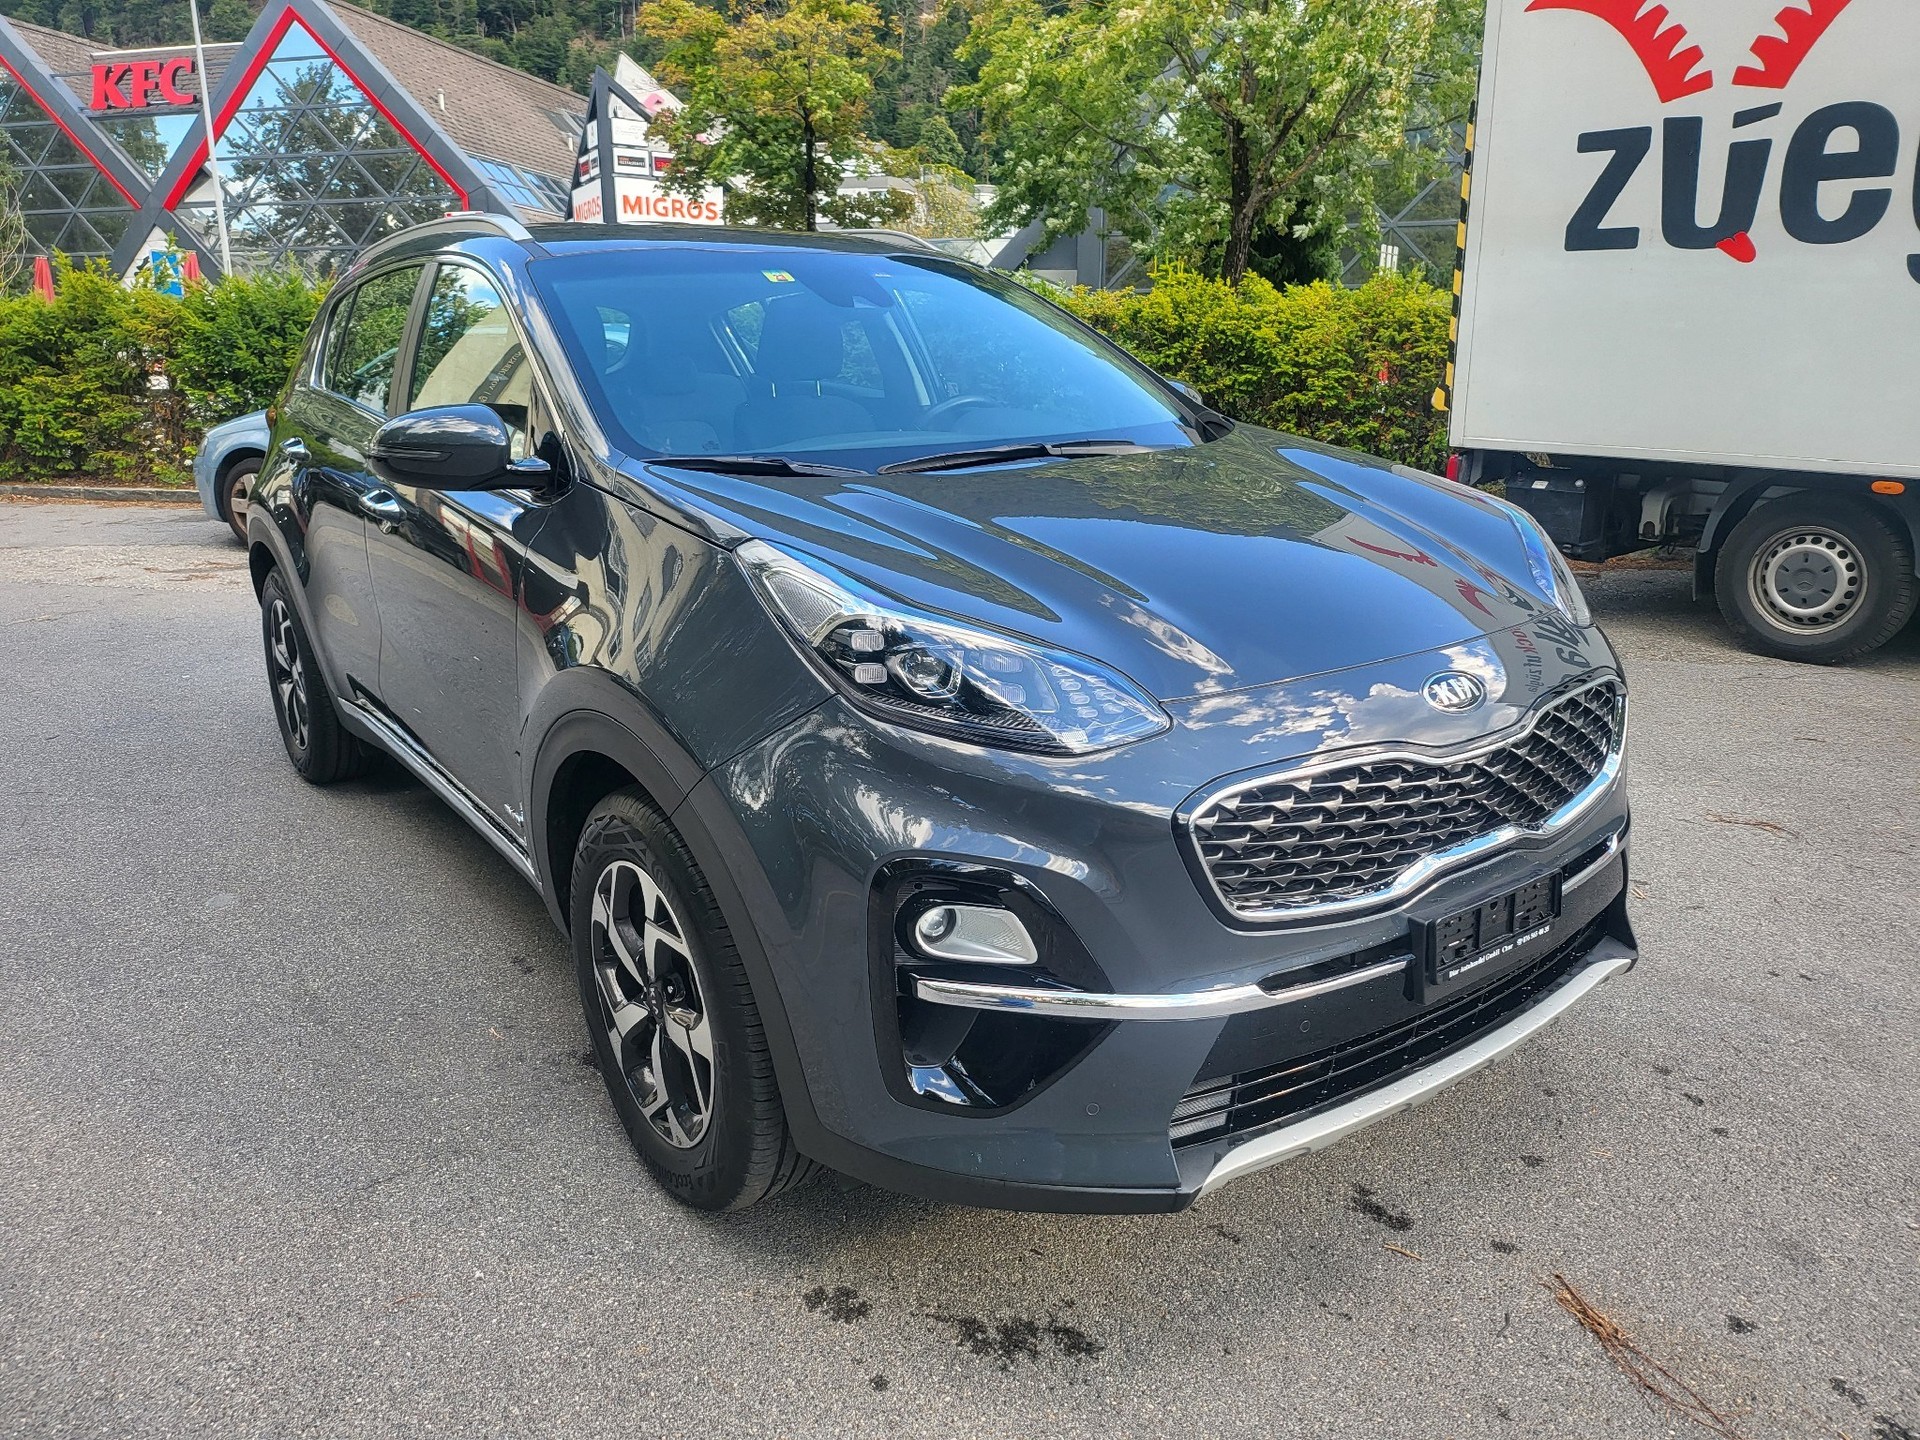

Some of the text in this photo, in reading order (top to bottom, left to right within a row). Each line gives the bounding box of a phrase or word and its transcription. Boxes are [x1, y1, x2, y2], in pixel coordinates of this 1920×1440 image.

[91, 57, 193, 110] KFC
[574, 196, 601, 221] MIGROS
[622, 194, 719, 221] MIGROS
[1430, 676, 1480, 706] KIA
